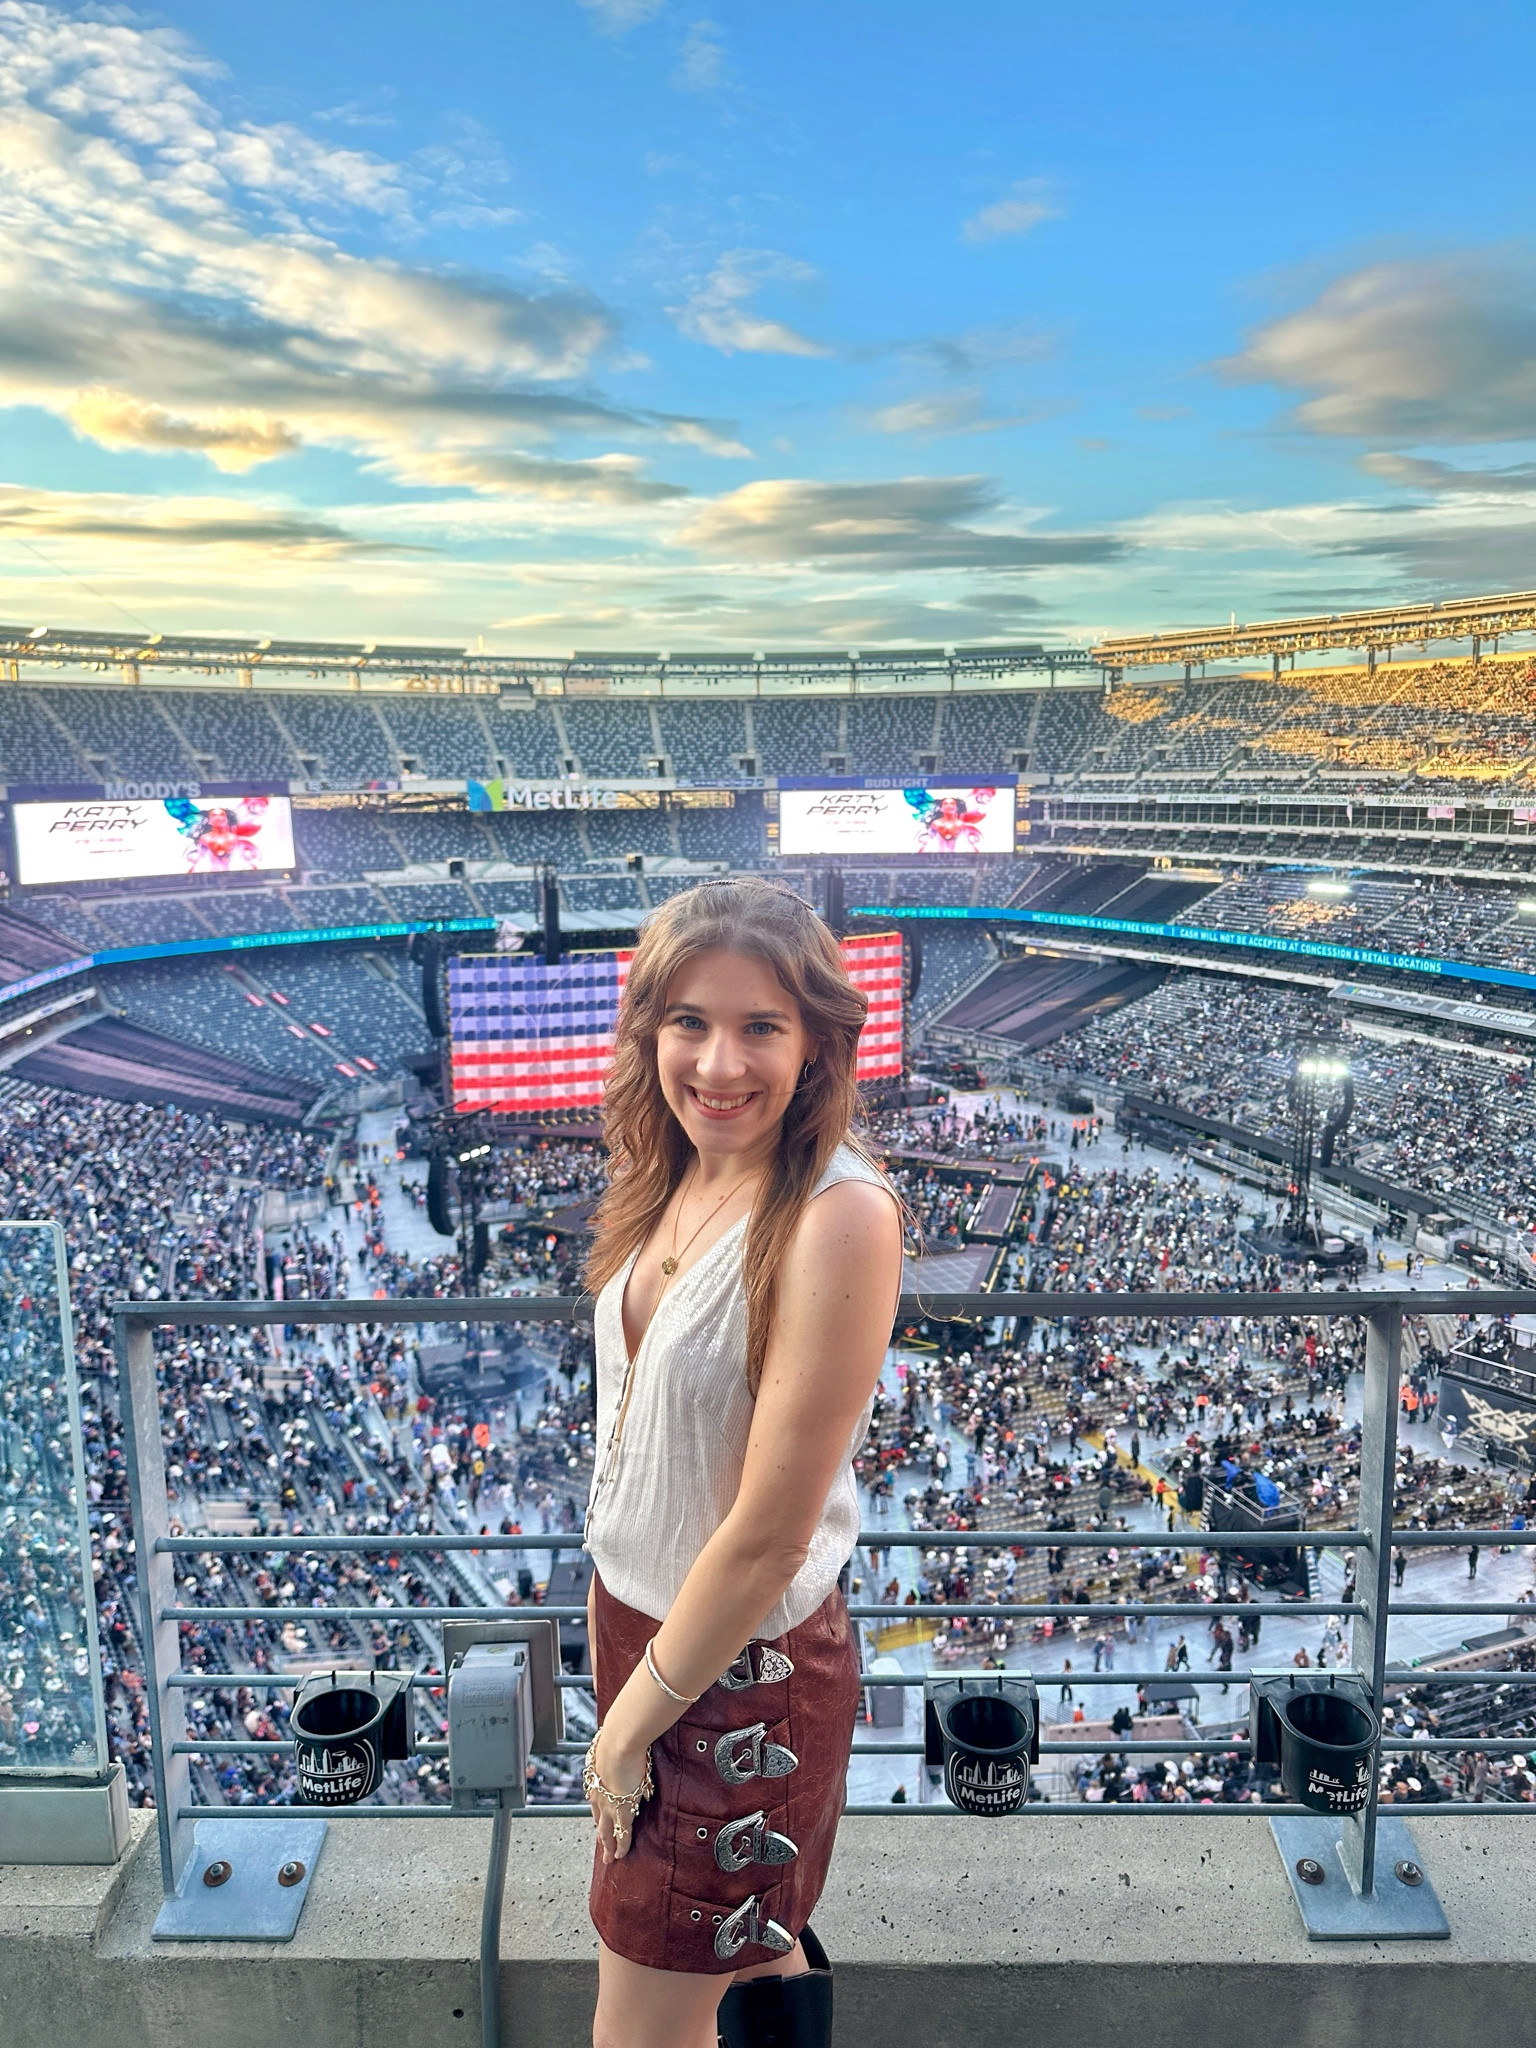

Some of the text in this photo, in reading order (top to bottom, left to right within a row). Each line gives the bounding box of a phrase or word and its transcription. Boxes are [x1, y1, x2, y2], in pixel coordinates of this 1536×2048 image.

[864, 778, 928, 787] BUD LIGHT
[105, 782, 200, 798] MOODY'S
[507, 785, 617, 810] MetLife
[820, 795, 884, 803] KATY
[1378, 797, 1391, 805] 99
[1497, 800, 1511, 808] 60
[64, 806, 141, 818] KATY
[806, 805, 888, 815] PERRY
[48, 819, 148, 833] PERRY
[1179, 929, 1198, 940] CASH
[1200, 931, 1219, 942] WILL
[1219, 933, 1235, 944] NOT
[1236, 935, 1248, 946] BE
[1248, 937, 1287, 950] ACCEPTED
[1288, 941, 1299, 952] AT
[1300, 943, 1352, 959] CONCESSION
[1353, 951, 1360, 960] &
[1361, 951, 1391, 965] RETAIL
[1393, 957, 1442, 973] LOCATIONS
[1452, 1005, 1535, 1028] METLIFE STADIUM
[302, 1776, 362, 1793] MetLife
[309, 1793, 353, 1801] STADIUM
[961, 1786, 1020, 1803] MetLife
